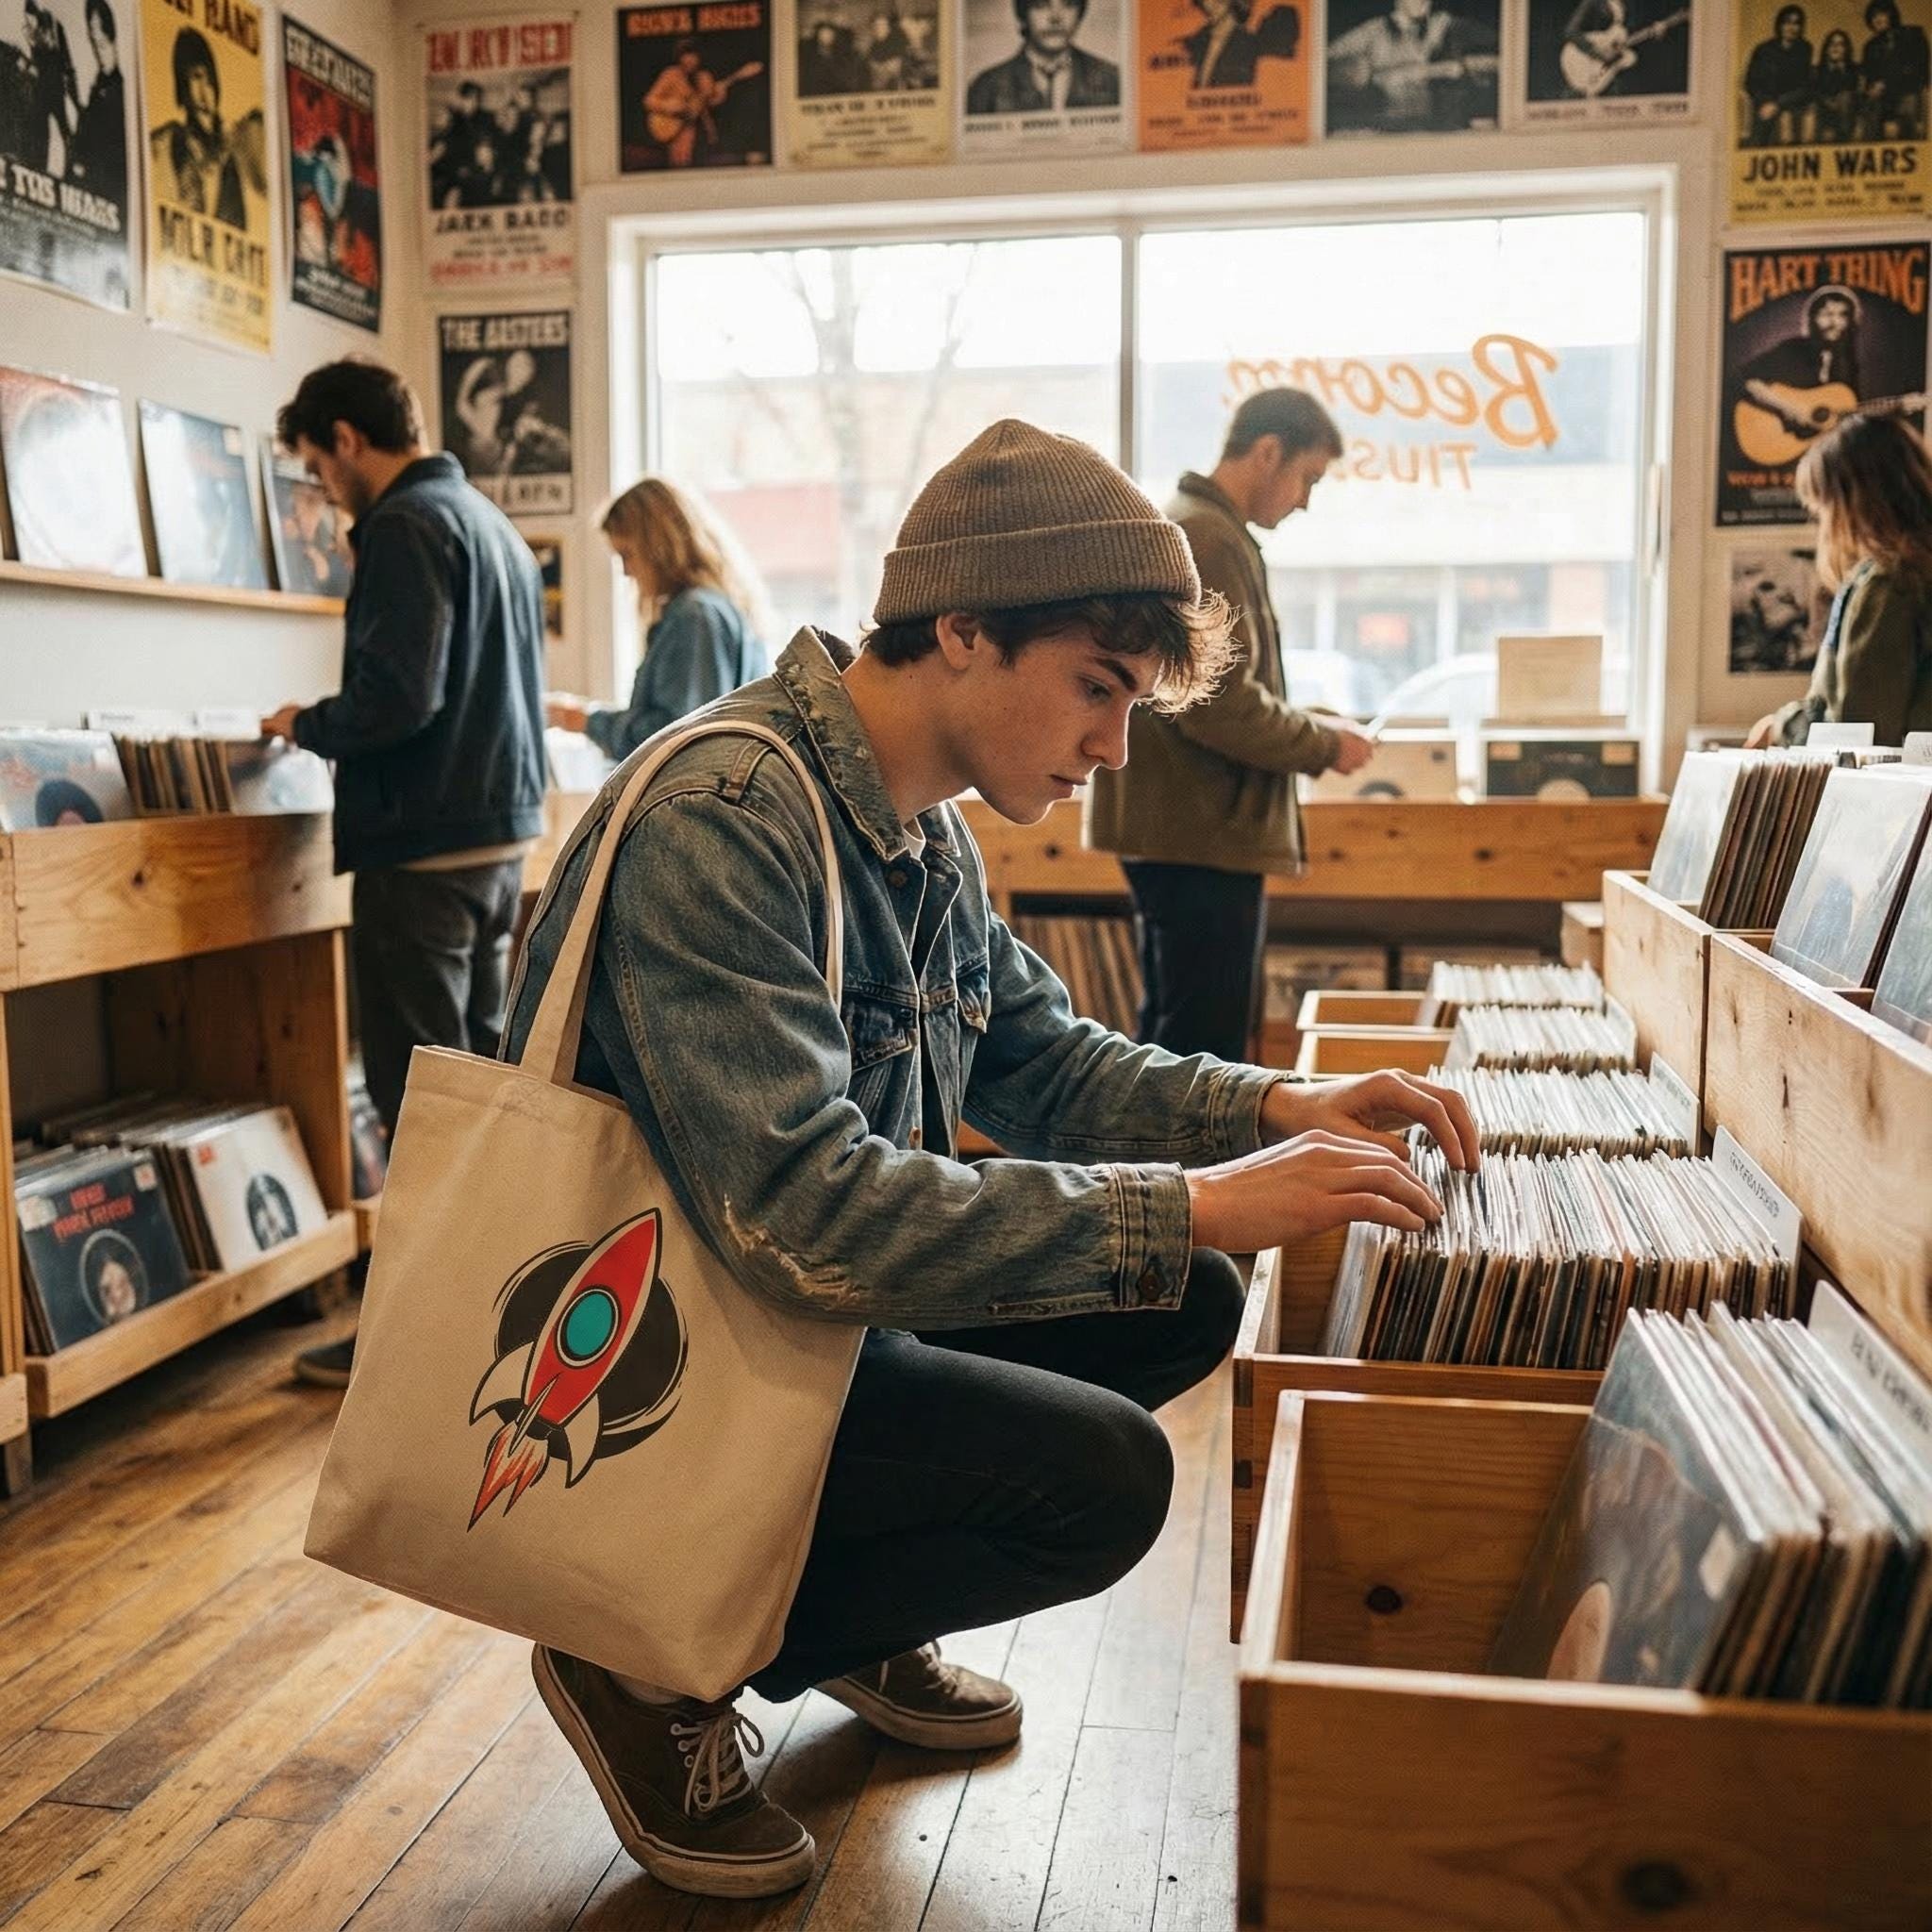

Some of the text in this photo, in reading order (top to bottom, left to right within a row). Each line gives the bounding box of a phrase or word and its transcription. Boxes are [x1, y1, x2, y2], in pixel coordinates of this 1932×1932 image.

[1743, 145, 1917, 183] JOHN WARS
[1729, 248, 1927, 324] HART THING
